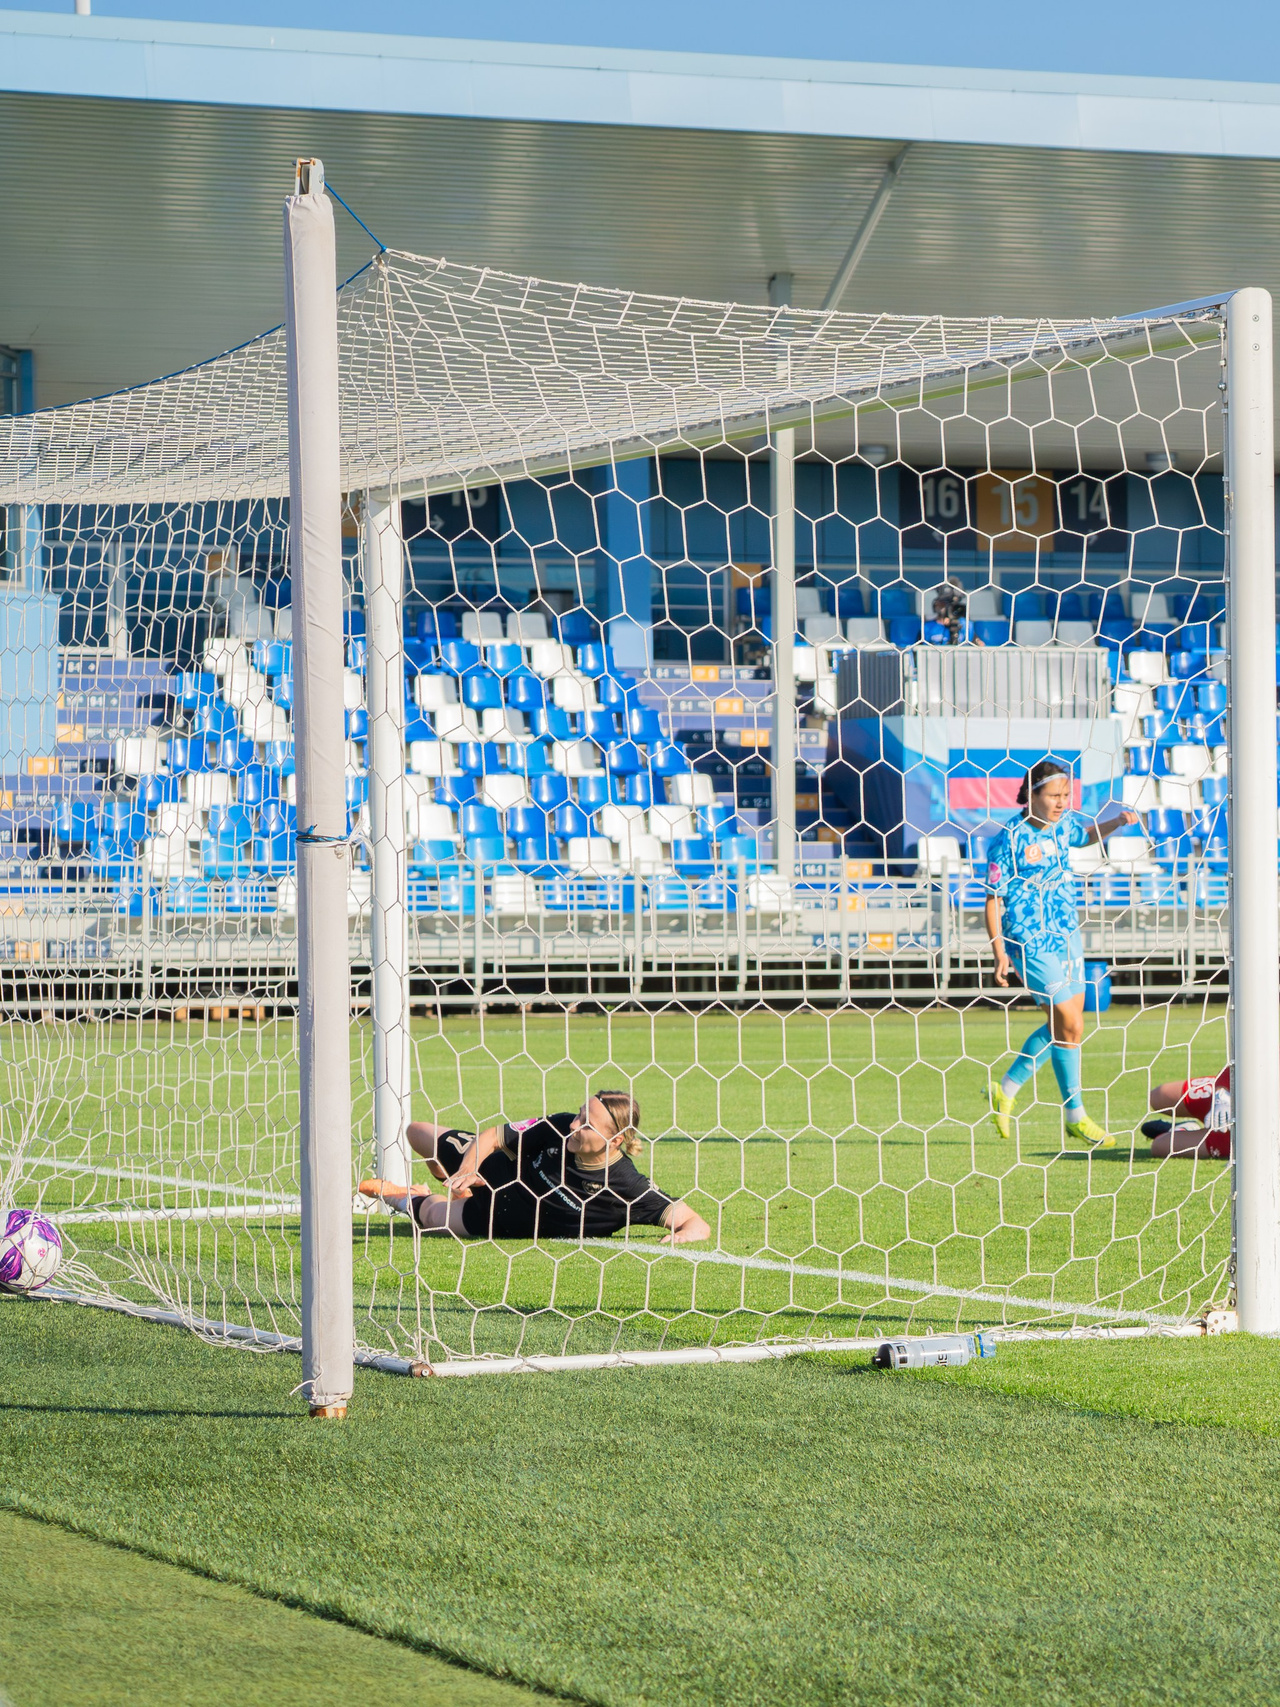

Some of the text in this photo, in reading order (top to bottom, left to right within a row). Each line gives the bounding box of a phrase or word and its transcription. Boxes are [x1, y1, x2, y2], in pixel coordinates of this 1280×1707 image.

[922, 477, 960, 519] 16
[991, 479, 1039, 526] 15
[1070, 480, 1112, 520] 14
